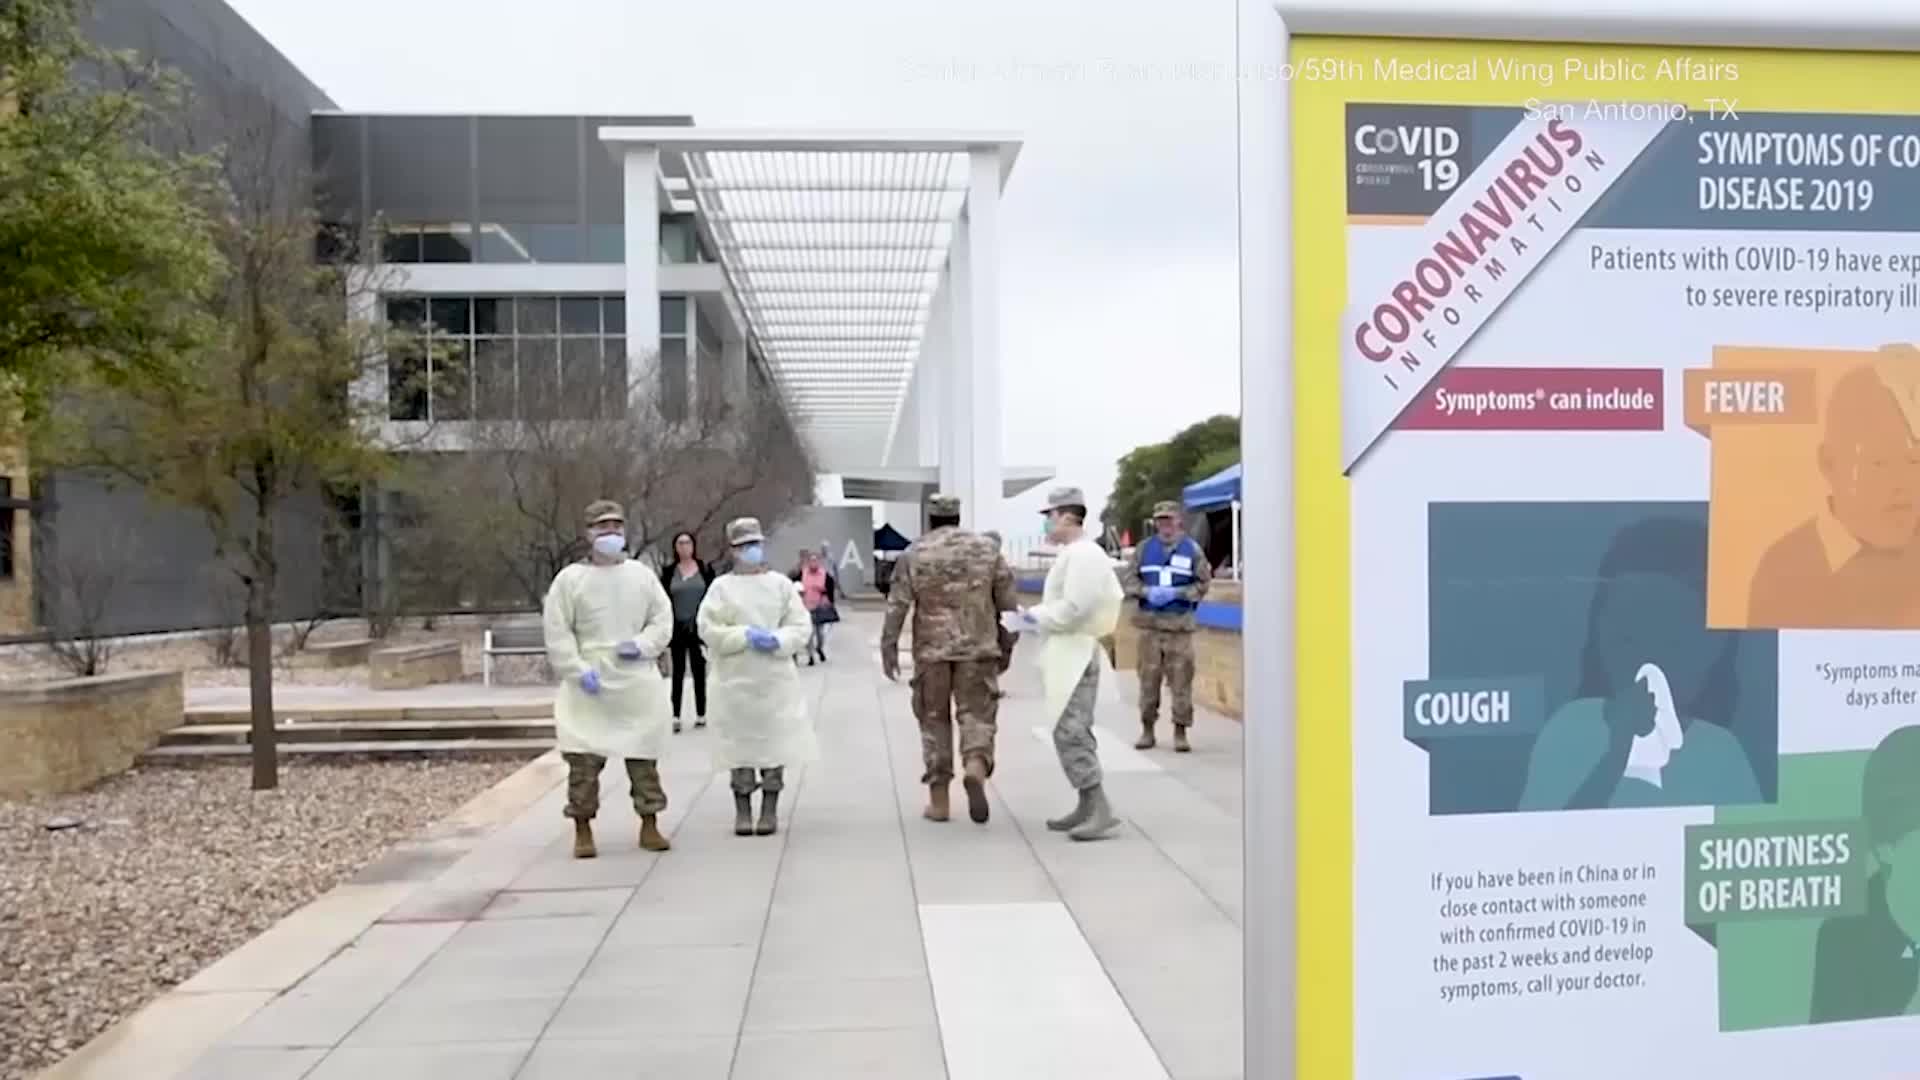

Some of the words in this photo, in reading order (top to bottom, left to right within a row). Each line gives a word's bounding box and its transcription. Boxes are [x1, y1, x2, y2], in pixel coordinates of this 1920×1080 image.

[1698, 131, 1845, 167] SYMPTOMS
[1850, 134, 1883, 167] OF
[1418, 159, 1460, 191] 19
[1699, 176, 1805, 210] DISEASE
[1810, 179, 1874, 211] 2019
[1355, 114, 1583, 363] CORONAVIRUS
[1383, 149, 1605, 391] INFORMATION
[1590, 245, 1676, 271] Patients
[1682, 247, 1729, 271] with
[1735, 246, 1829, 272] COVID-19
[1835, 247, 1882, 272] have
[1686, 285, 1707, 307] to
[1712, 287, 1779, 307] severe
[1784, 283, 1894, 312] respiratory
[1550, 394, 1582, 410] can
[1586, 388, 1655, 411] include
[1704, 381, 1785, 413] FEVER
[839, 539, 864, 569] A
[1414, 691, 1511, 725] COUGH
[1846, 687, 1879, 710] days
[1881, 686, 1917, 705] after
[1699, 833, 1850, 871] SHORTNESS
[1431, 871, 1443, 891] If
[1446, 875, 1474, 894] you
[1477, 869, 1514, 888] have
[1517, 868, 1556, 888] been
[1559, 868, 1573, 885] in
[1576, 864, 1619, 884] China
[1622, 866, 1639, 881] or
[1642, 863, 1657, 881] in
[1699, 880, 1733, 912] OF
[1739, 875, 1842, 911] BREATH
[1440, 898, 1478, 919] close
[1481, 896, 1538, 916] contact
[1541, 892, 1577, 912] with
[1579, 892, 1648, 911] someone
[1440, 925, 1476, 945] with
[1479, 921, 1556, 943] confirmed
[1559, 917, 1629, 938] COVID-19
[1632, 916, 1647, 934] in
[1433, 954, 1459, 973] the
[1462, 954, 1495, 976] past
[1498, 951, 1508, 970] 2
[1511, 947, 1560, 968] weeks
[1562, 945, 1591, 965] and
[1594, 942, 1654, 964] develop
[1440, 979, 1524, 1003] symptoms,
[1527, 974, 1553, 994] call
[1556, 975, 1591, 996] your
[1593, 970, 1647, 990] doctor.
